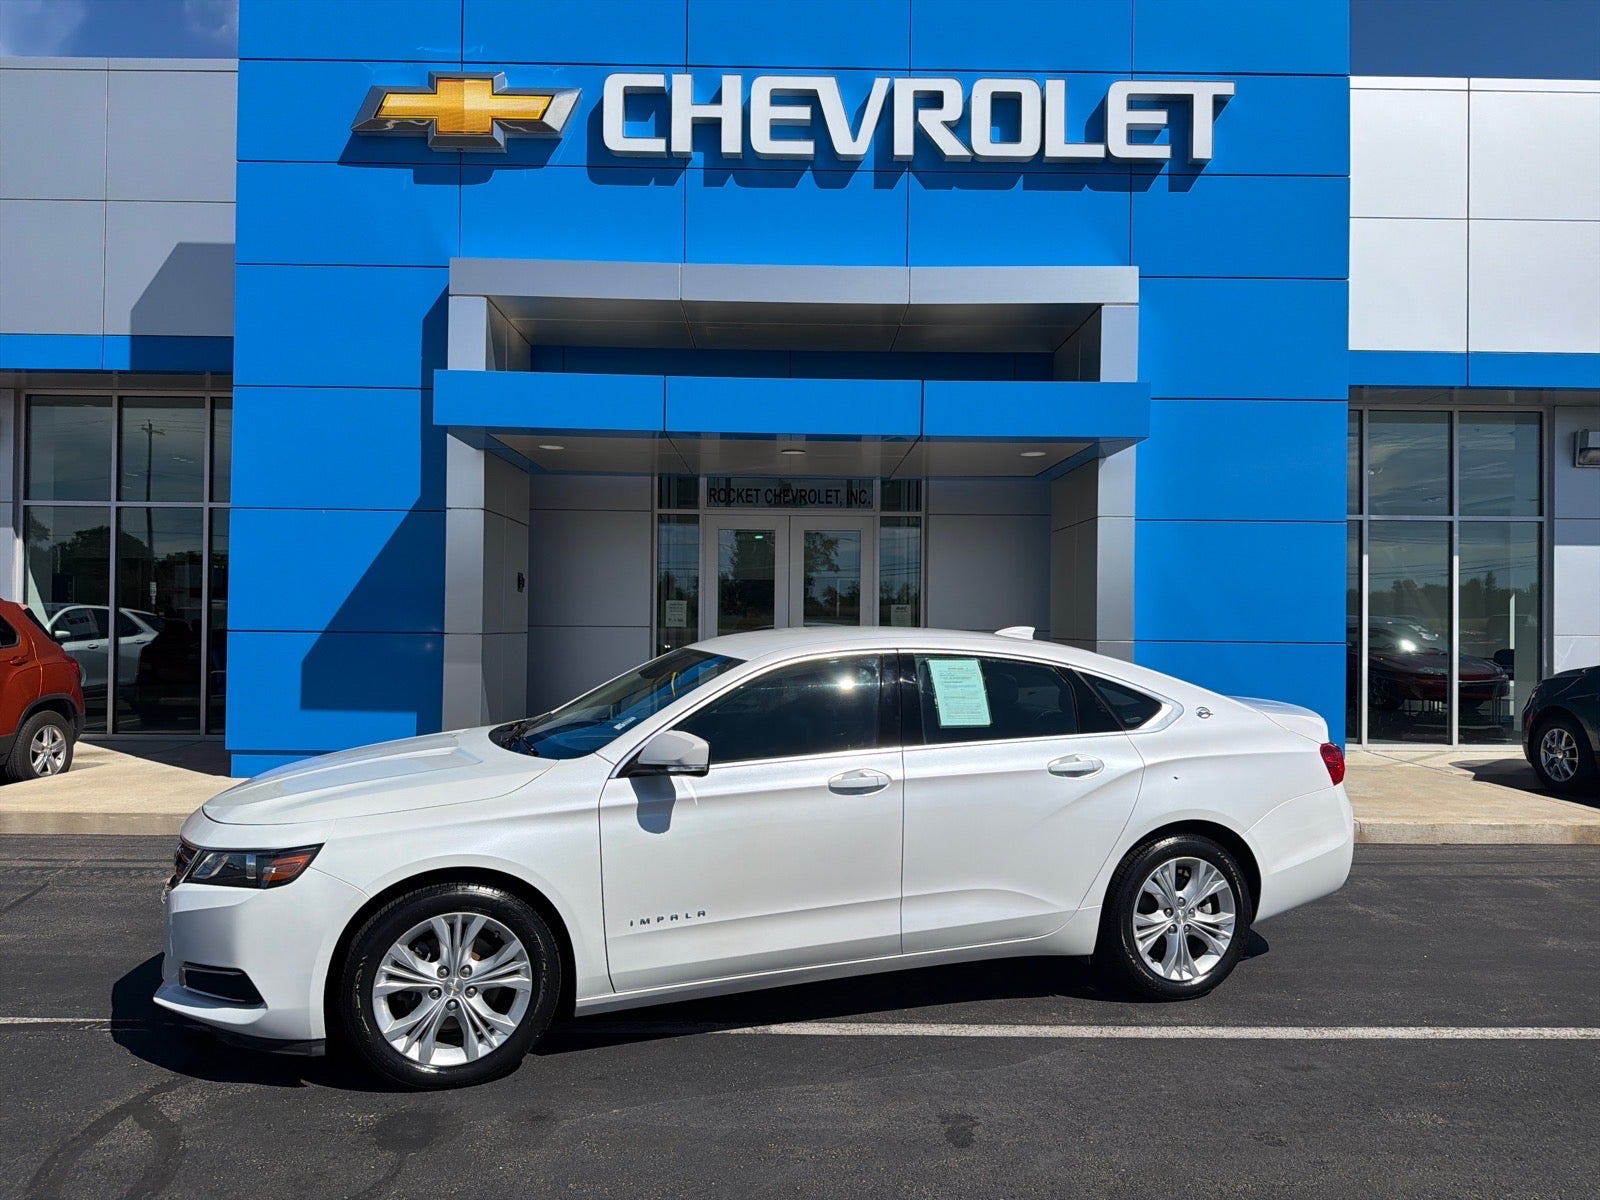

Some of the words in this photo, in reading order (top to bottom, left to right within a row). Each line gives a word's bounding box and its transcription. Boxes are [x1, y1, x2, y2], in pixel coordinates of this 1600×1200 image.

[603, 73, 1236, 160] CHEVROLET
[708, 487, 761, 504] ROCKET
[764, 488, 843, 507] CHEVROLET,
[846, 489, 871, 505] INC.
[629, 910, 706, 927] IMPALA
